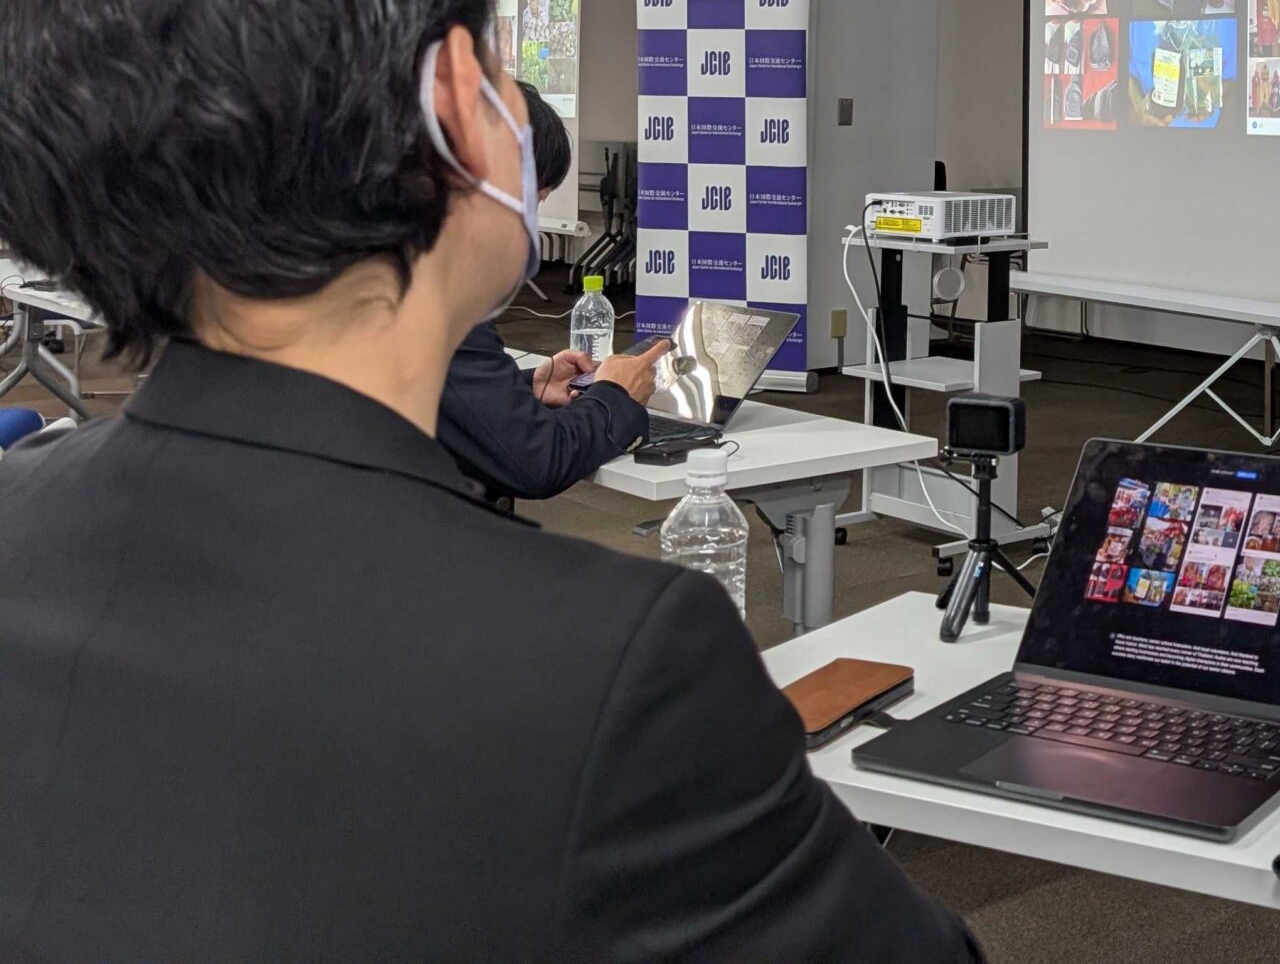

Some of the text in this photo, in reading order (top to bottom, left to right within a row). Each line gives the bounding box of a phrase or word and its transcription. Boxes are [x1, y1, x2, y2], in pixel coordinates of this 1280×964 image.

[700, 51, 730, 76] JCIE
[644, 116, 674, 141] JCIE
[760, 118, 790, 144] JCIE
[701, 185, 731, 211] JCIE
[645, 250, 675, 275] JCIE
[760, 254, 791, 281] JCIE
